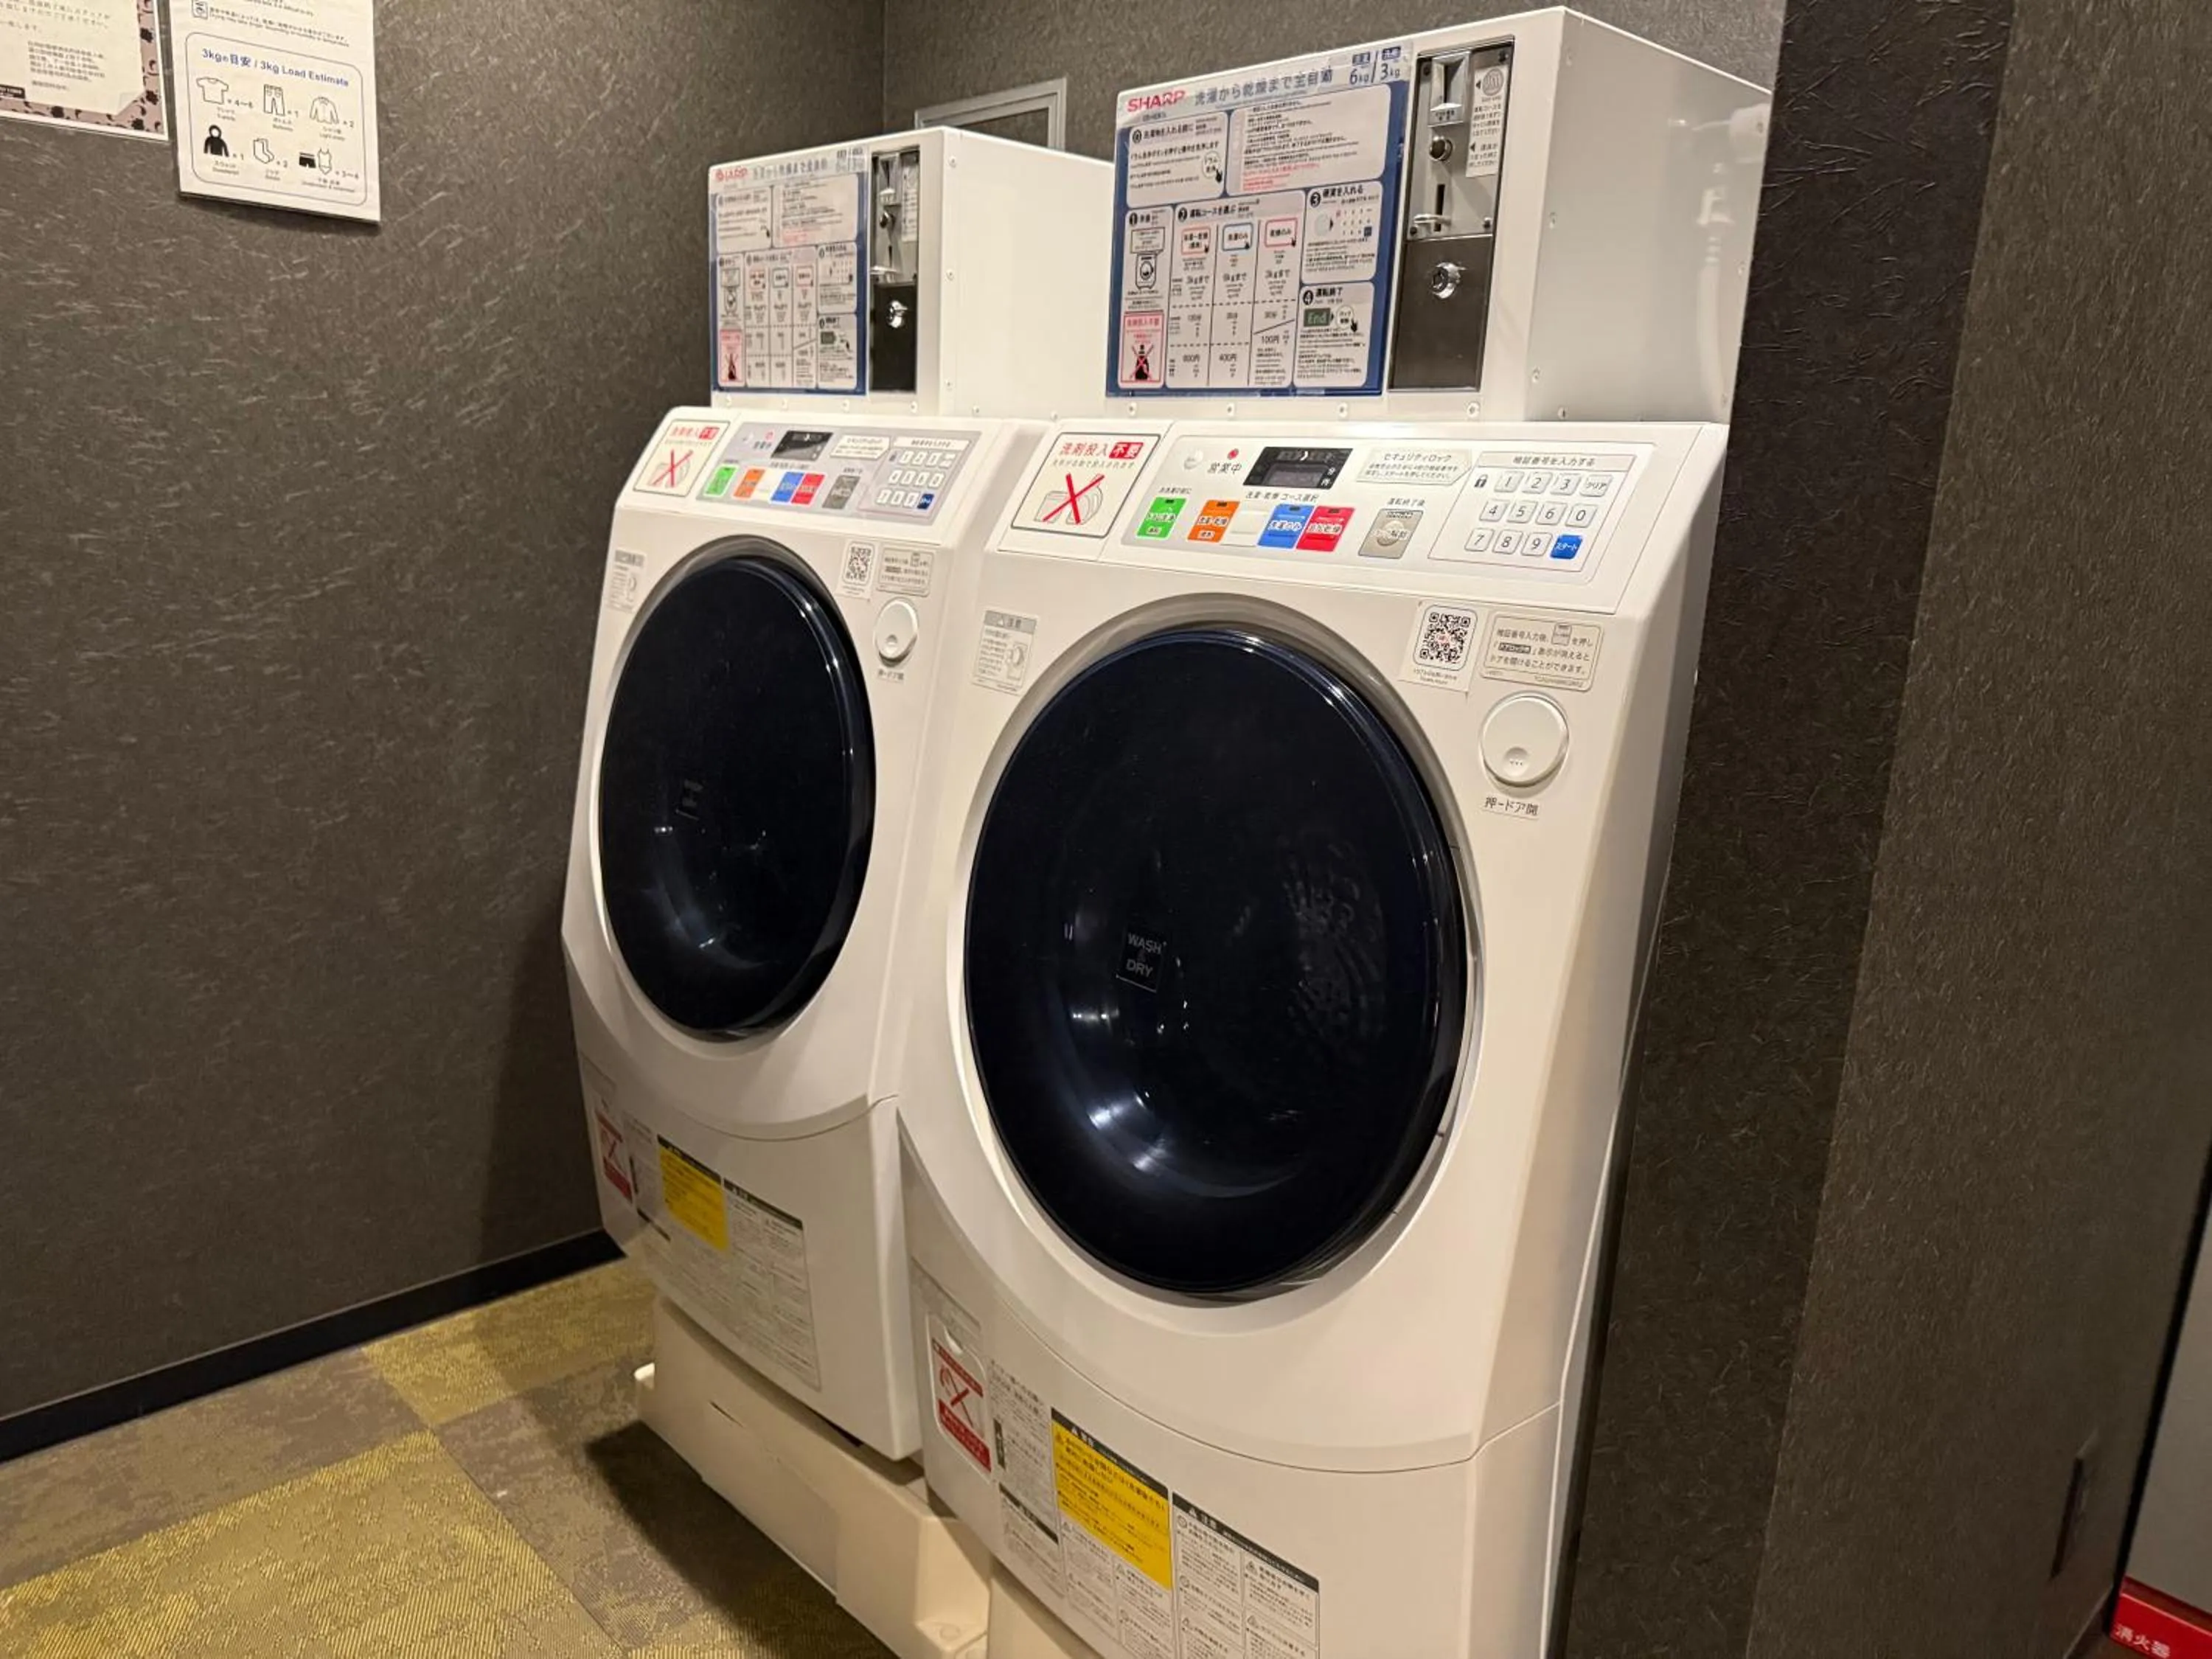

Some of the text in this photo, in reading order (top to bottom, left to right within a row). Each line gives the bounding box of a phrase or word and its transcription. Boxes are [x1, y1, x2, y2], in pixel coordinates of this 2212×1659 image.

[260, 60, 279, 74] 3kg
[282, 65, 306, 79] Load
[308, 69, 349, 87] Estimate
[1127, 89, 1186, 113] SHARP
[1383, 453, 1452, 463] セキュリティロック
[1513, 456, 1595, 467] 暗証番号を入力する
[1207, 462, 1242, 474] 営業中
[1505, 476, 1512, 487] 1
[1531, 477, 1542, 489] 2
[1559, 479, 1571, 490] 3
[1489, 506, 1586, 521] 4 5 6 0
[1475, 534, 1578, 552] 7 8 9 スタート
[1127, 933, 1162, 954] WASH
[1125, 959, 1154, 977] DRY
[2115, 1624, 2171, 1659] 消火器
